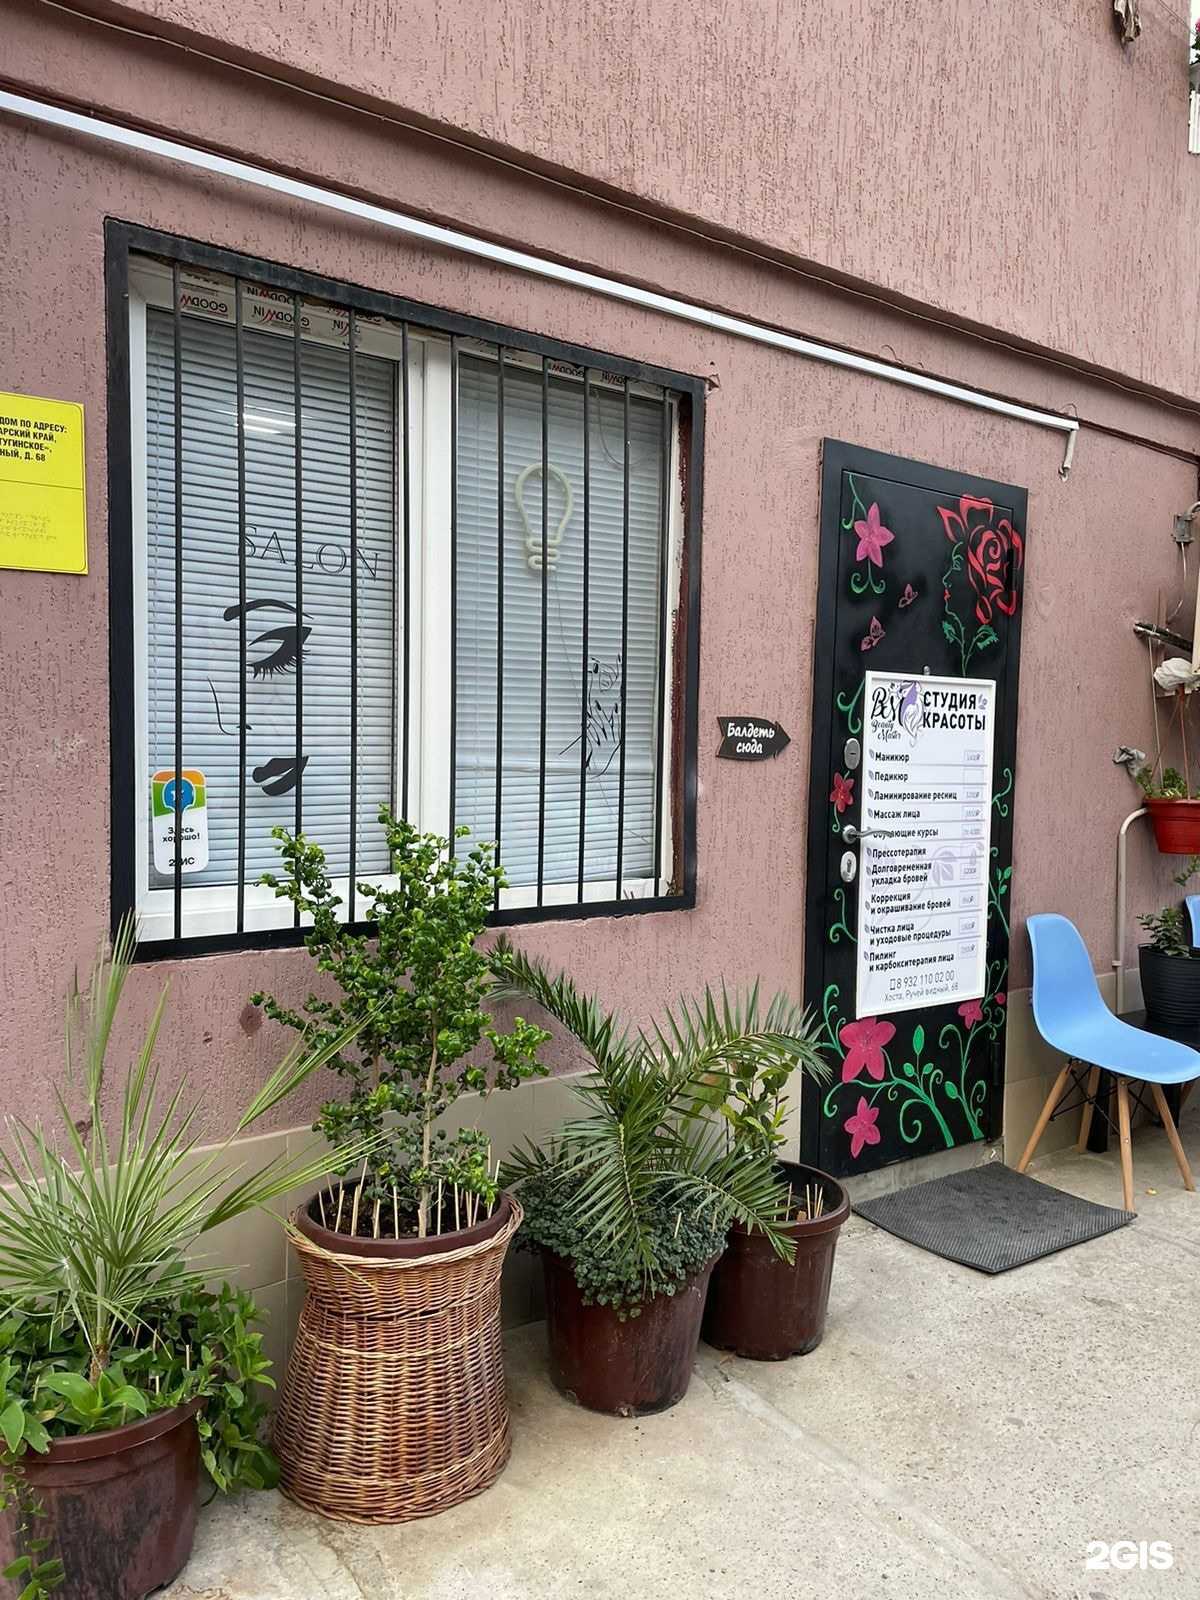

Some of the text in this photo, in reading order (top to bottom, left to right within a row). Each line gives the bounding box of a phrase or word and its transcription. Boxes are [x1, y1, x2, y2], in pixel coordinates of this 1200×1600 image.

[20, 419, 31, 428] ПО
[33, 421, 68, 433] АДРЕСУ:
[33, 431, 57, 443] КРАЙ,
[24, 452, 34, 460] Д.
[35, 453, 46, 462] 68
[923, 691, 977, 711] СТУДИЯ
[922, 712, 986, 731] КРАСОТЫ
[727, 722, 775, 739] Балдеть
[736, 738, 763, 754] сюда
[875, 751, 910, 763] Маникюр
[874, 771, 909, 782] Педикюр
[873, 791, 932, 801] Ламинирование
[933, 791, 957, 801] ресниц
[873, 809, 920, 819] Массаж лица
[168, 826, 194, 835] Зесь
[917, 828, 939, 838] курсы
[872, 848, 926, 859] Прессотерапия
[168, 857, 195, 867] 2ИС
[871, 862, 932, 875] Долговременная
[871, 873, 928, 887] укладка бровей
[870, 892, 911, 904] Коррекция
[870, 907, 876, 915] и
[876, 903, 926, 915] окрашивание
[926, 898, 951, 909] бровей
[870, 922, 914, 935] Чистка лица
[869, 930, 951, 946] и уходовые процедуры
[869, 951, 896, 962] Пилинг
[875, 957, 936, 972] карбокситерапия
[937, 953, 954, 963] лица
[903, 976, 917, 988] 932
[920, 973, 933, 984] 110
[935, 971, 944, 983] 02
[945, 970, 954, 981] 00
